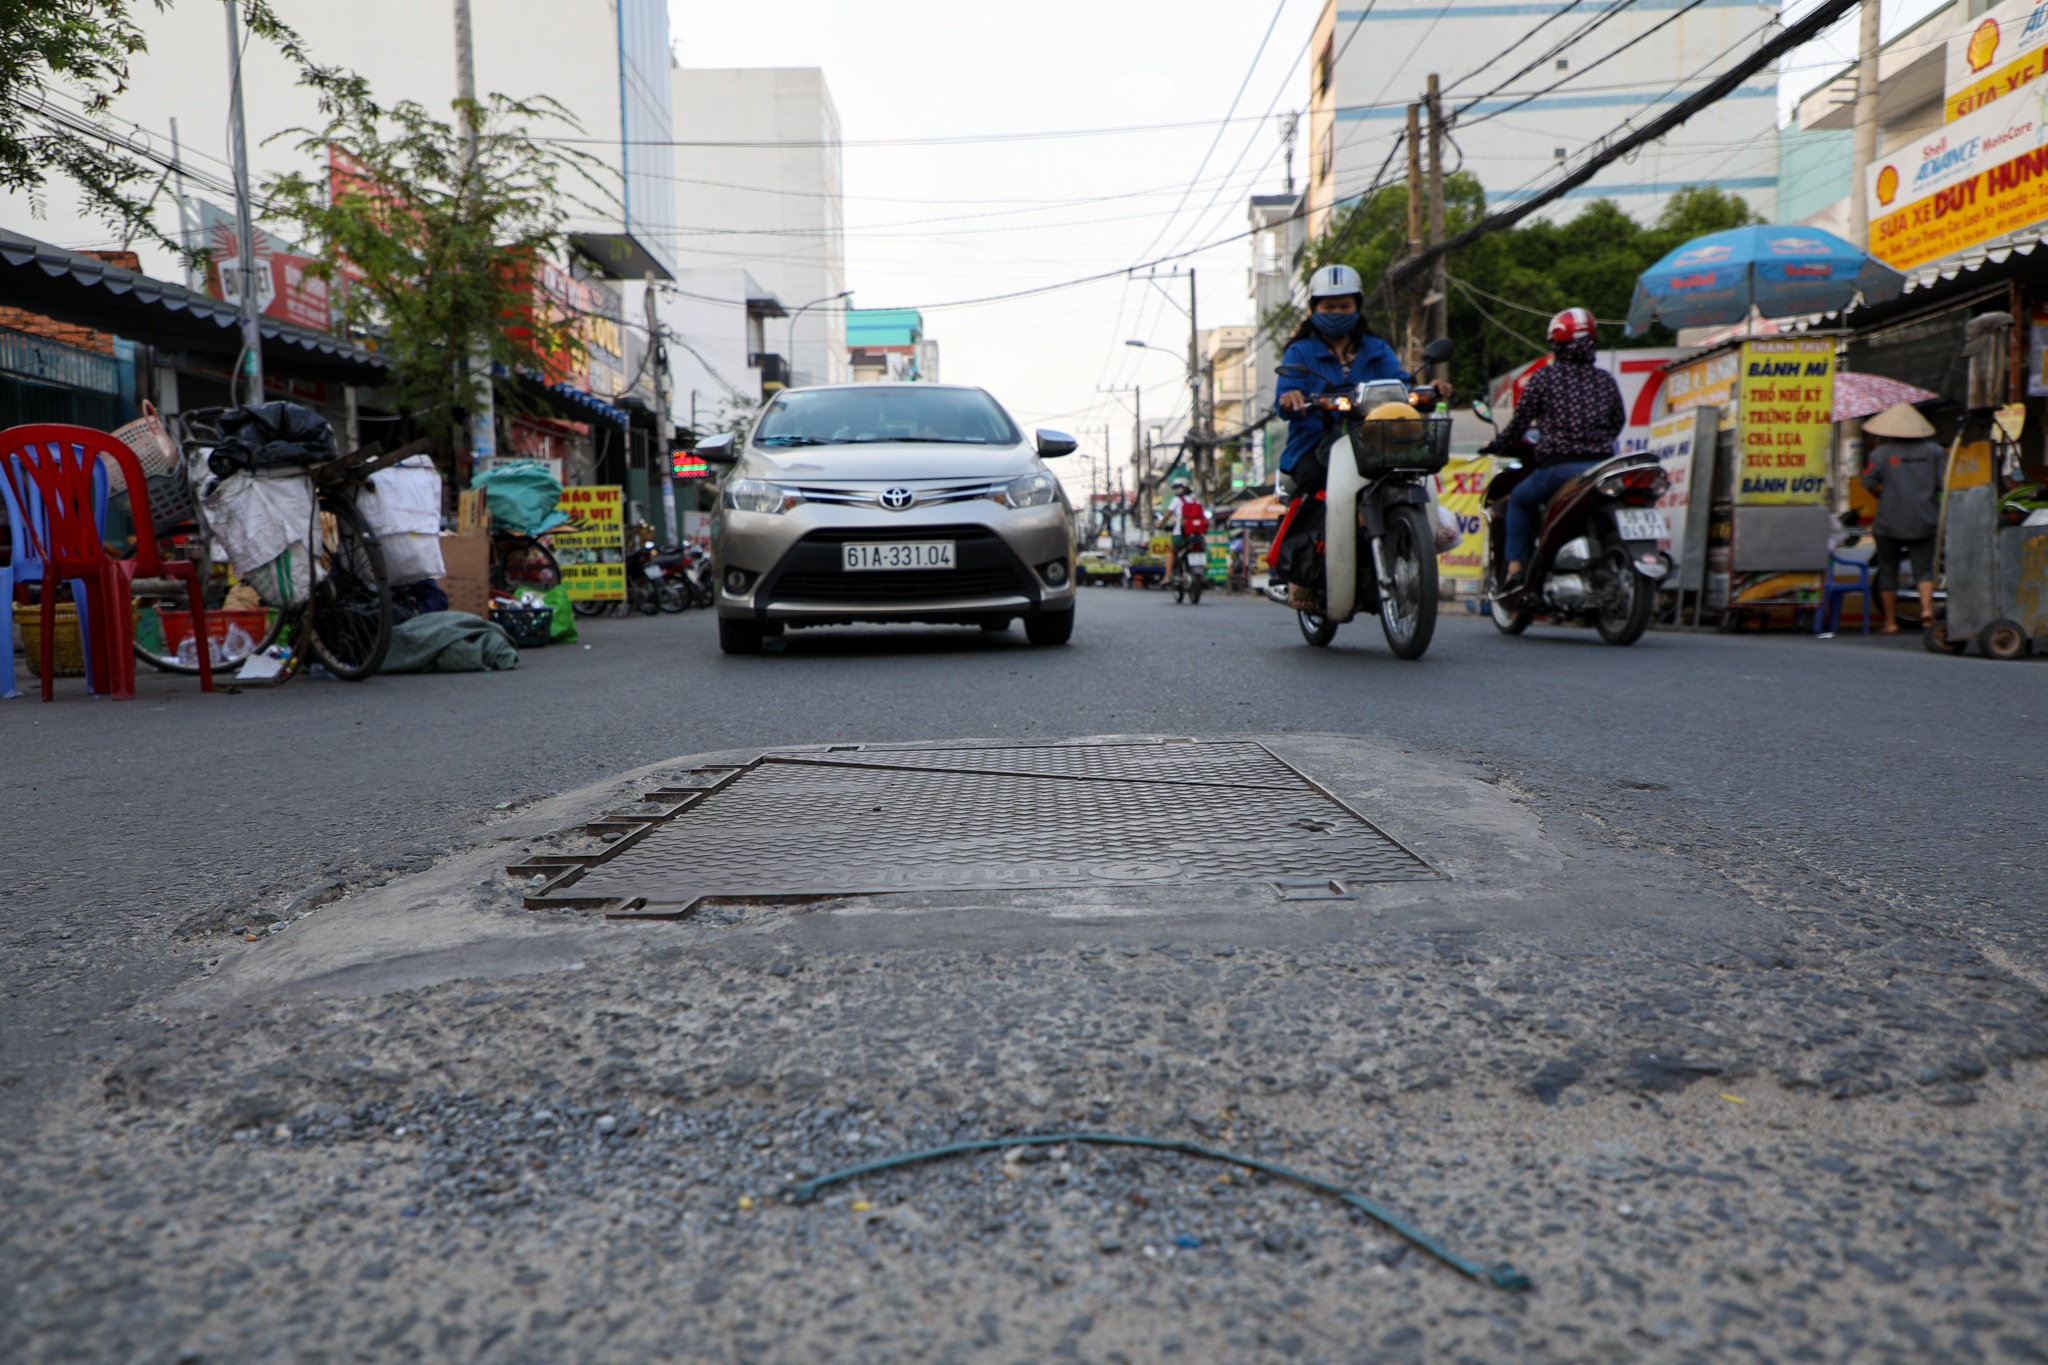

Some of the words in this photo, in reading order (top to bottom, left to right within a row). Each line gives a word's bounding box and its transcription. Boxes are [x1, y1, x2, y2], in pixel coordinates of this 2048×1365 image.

[1912, 134, 1982, 185] ADVANCE
[1982, 121, 2033, 152] MotoCare
[1923, 137, 1948, 160] Shell
[1912, 203, 1932, 228] XE
[1935, 173, 1980, 219] DUY
[1748, 357, 1802, 377] BÁNH
[1814, 409, 1832, 424] LA
[1452, 473, 1486, 495] XE
[1741, 473, 1788, 494] BÁNH
[597, 489, 619, 504] VỊT
[590, 507, 613, 521] VỊT
[847, 545, 951, 567] 61A-331.04
